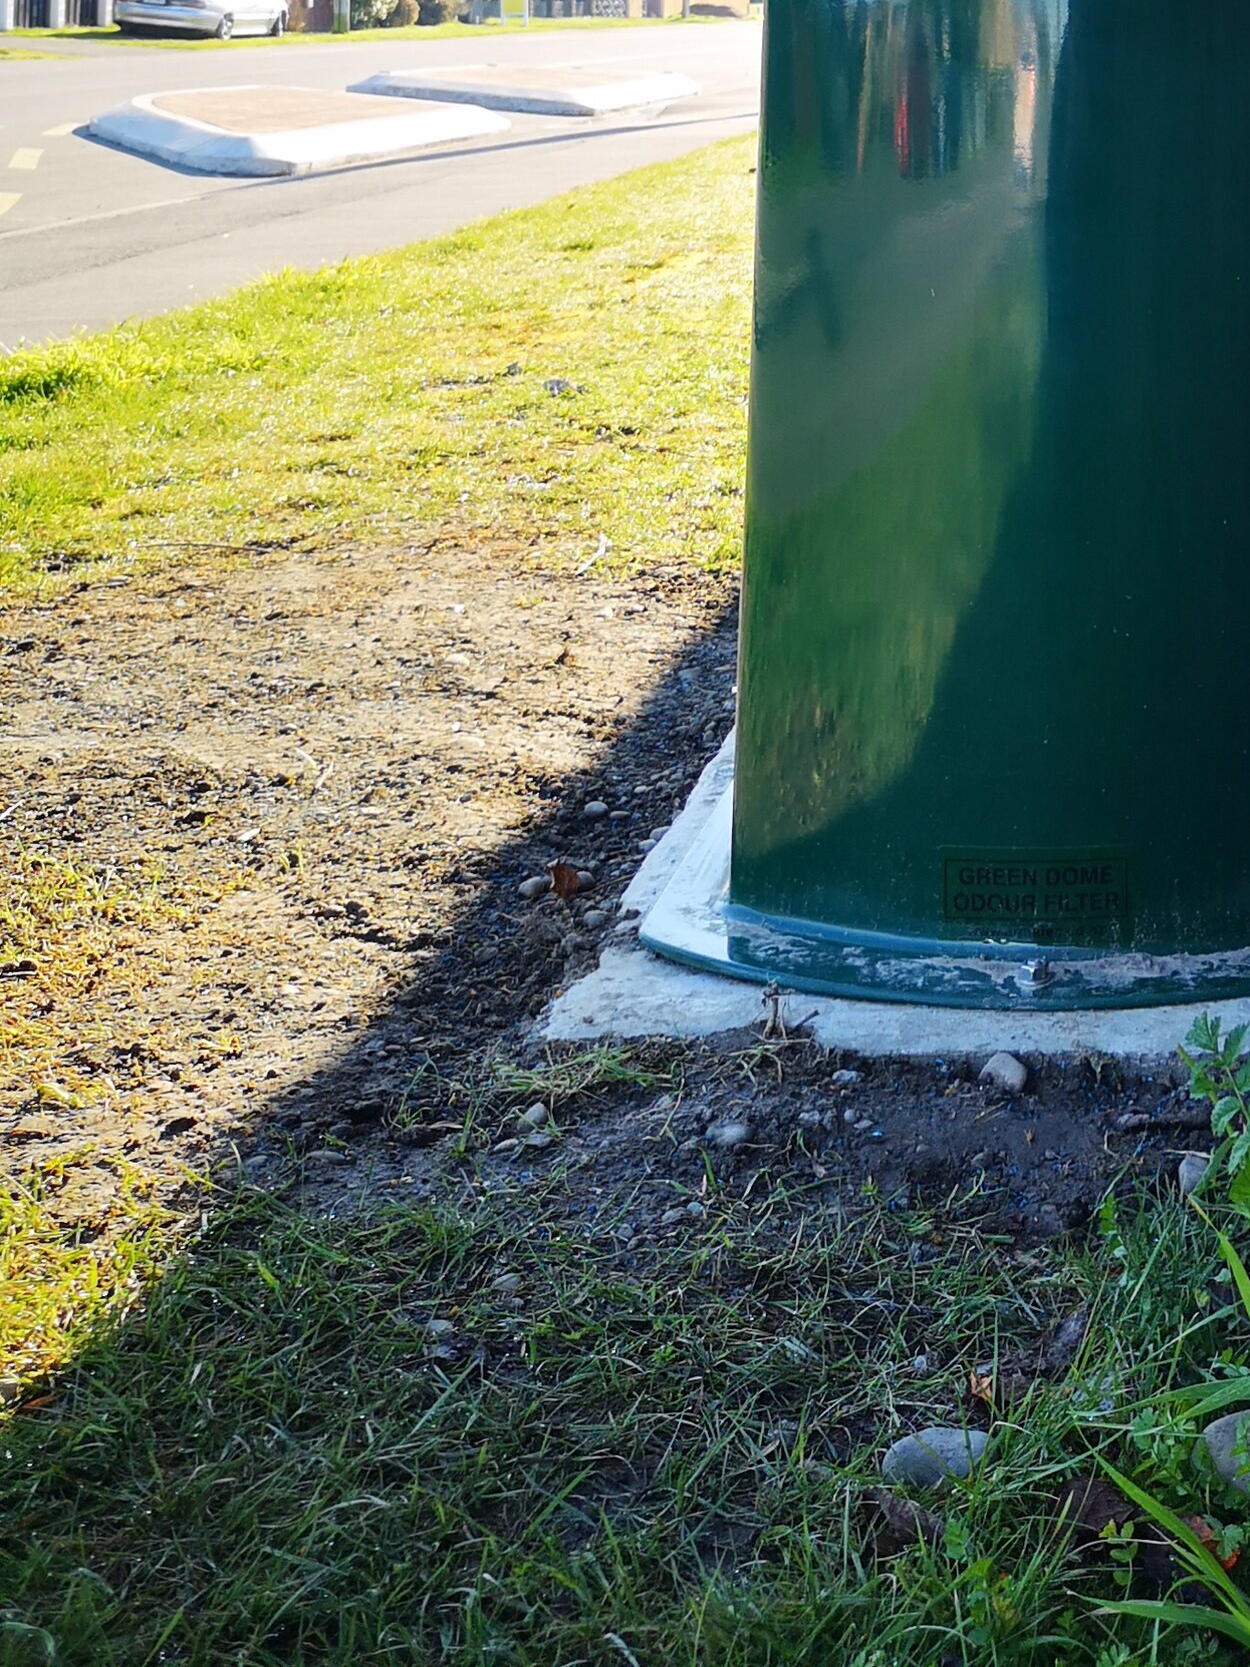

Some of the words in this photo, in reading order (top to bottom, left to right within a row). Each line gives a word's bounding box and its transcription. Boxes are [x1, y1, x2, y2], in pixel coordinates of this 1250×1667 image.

[959, 866, 1037, 886] GREEN
[1045, 866, 1114, 885] DOME
[954, 892, 1035, 913] ODOUR
[1044, 892, 1119, 913] FILTER
